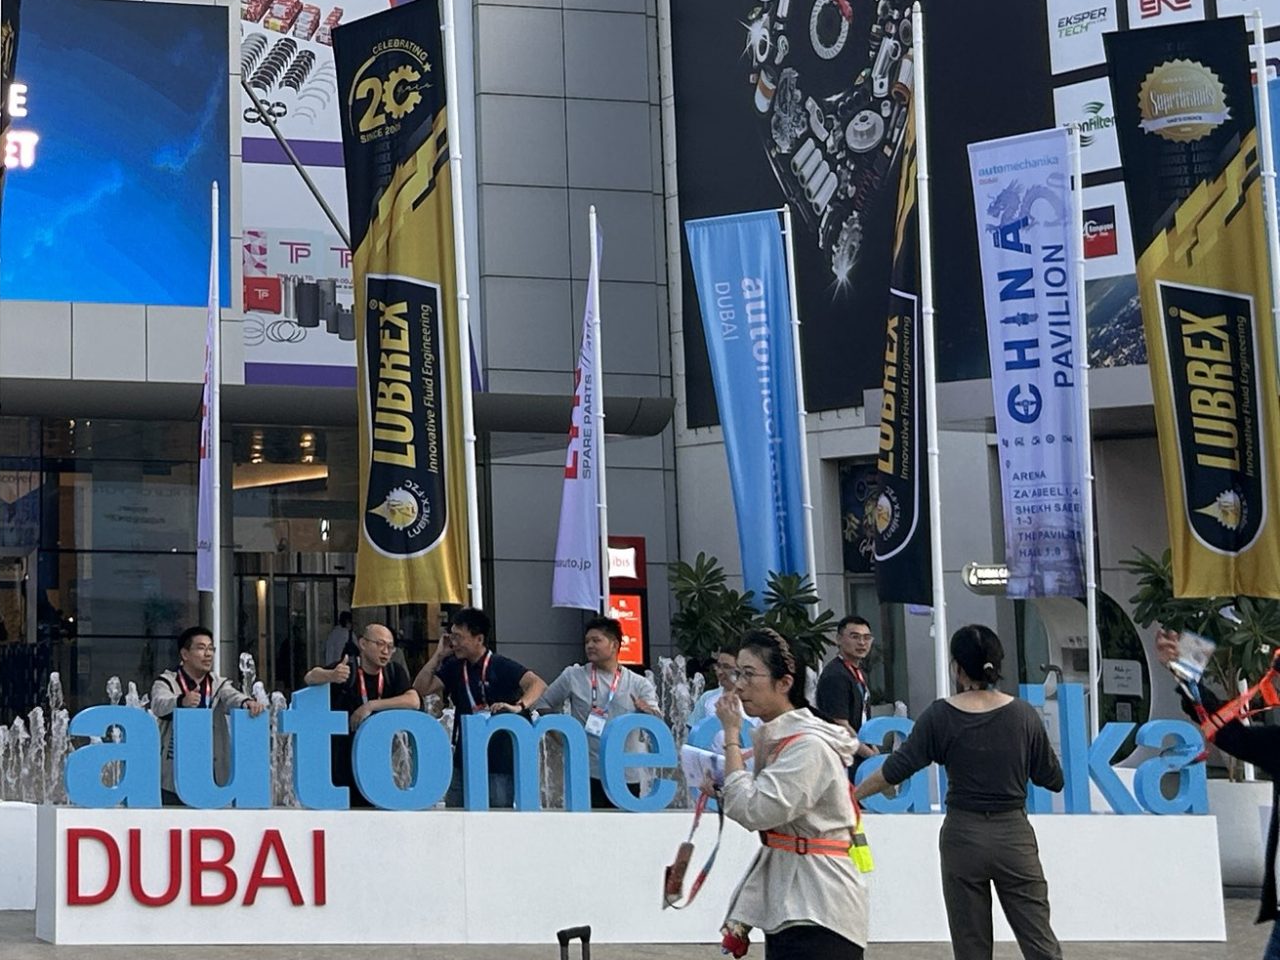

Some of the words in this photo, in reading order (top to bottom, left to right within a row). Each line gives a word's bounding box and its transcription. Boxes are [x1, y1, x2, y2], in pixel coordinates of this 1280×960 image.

[1057, 7, 1107, 28] EKSPER
[1058, 22, 1089, 38] TECH
[372, 38, 429, 61] CELEBRATING
[279, 241, 312, 264] TP
[420, 304, 435, 376] Engineering
[714, 281, 739, 341] DUBAI
[1042, 243, 1075, 389] PAVILION
[900, 315, 912, 385] Engineering
[1235, 314, 1251, 384] Engineering
[373, 300, 416, 469] LUBREX
[422, 378, 436, 407] Fluid
[584, 374, 593, 424] PARTS
[900, 388, 910, 417] Fluid
[1178, 307, 1241, 472] LUBREX
[424, 409, 439, 474] Innovative
[582, 429, 592, 480] SPARE
[899, 419, 910, 480] Innovative
[1242, 416, 1255, 477] Innovative
[1012, 470, 1047, 481] ARENA
[1054, 503, 1081, 513] SAEE
[612, 556, 631, 567] ibis
[65, 683, 1210, 816] automeaika
[66, 828, 328, 908] DUBAI
